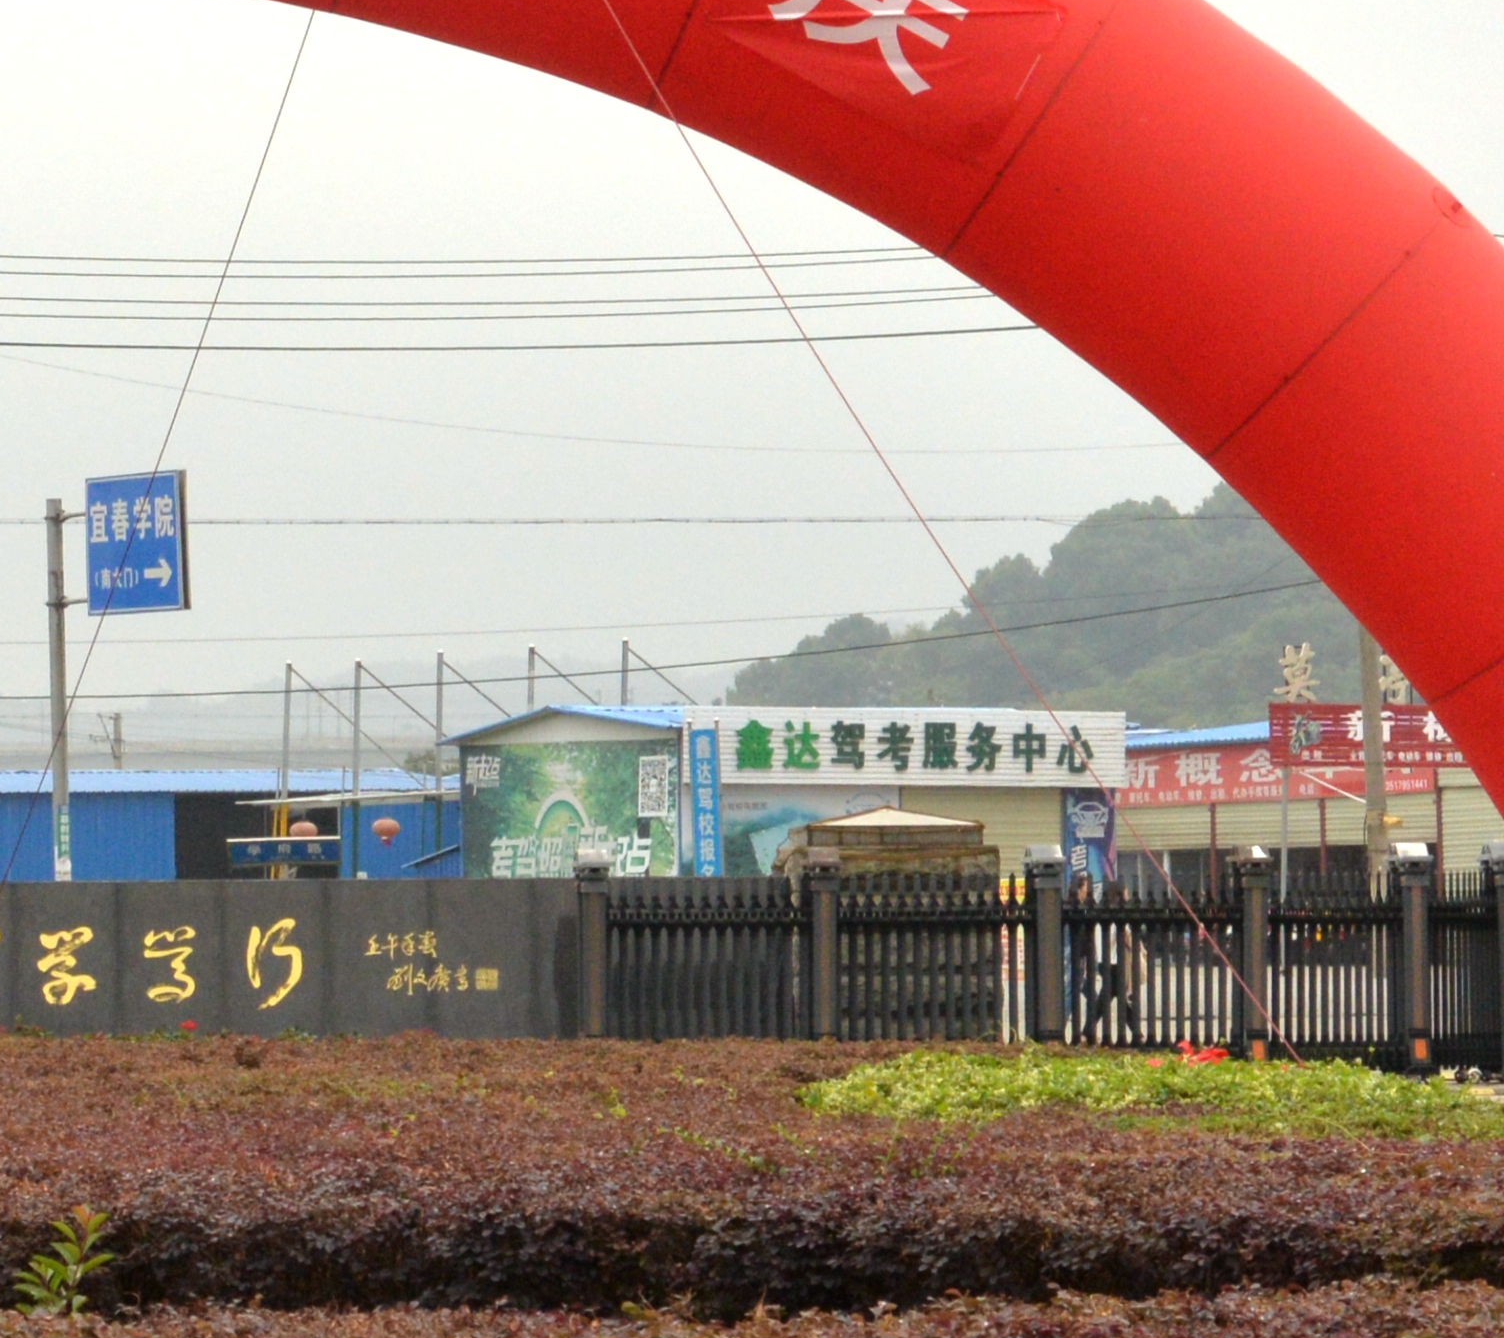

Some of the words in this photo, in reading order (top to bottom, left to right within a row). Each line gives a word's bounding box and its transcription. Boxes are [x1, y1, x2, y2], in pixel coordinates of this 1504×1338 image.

[90, 494, 174, 543] 宜春学院
[735, 719, 1095, 774] 鑫达驾考服务中心
